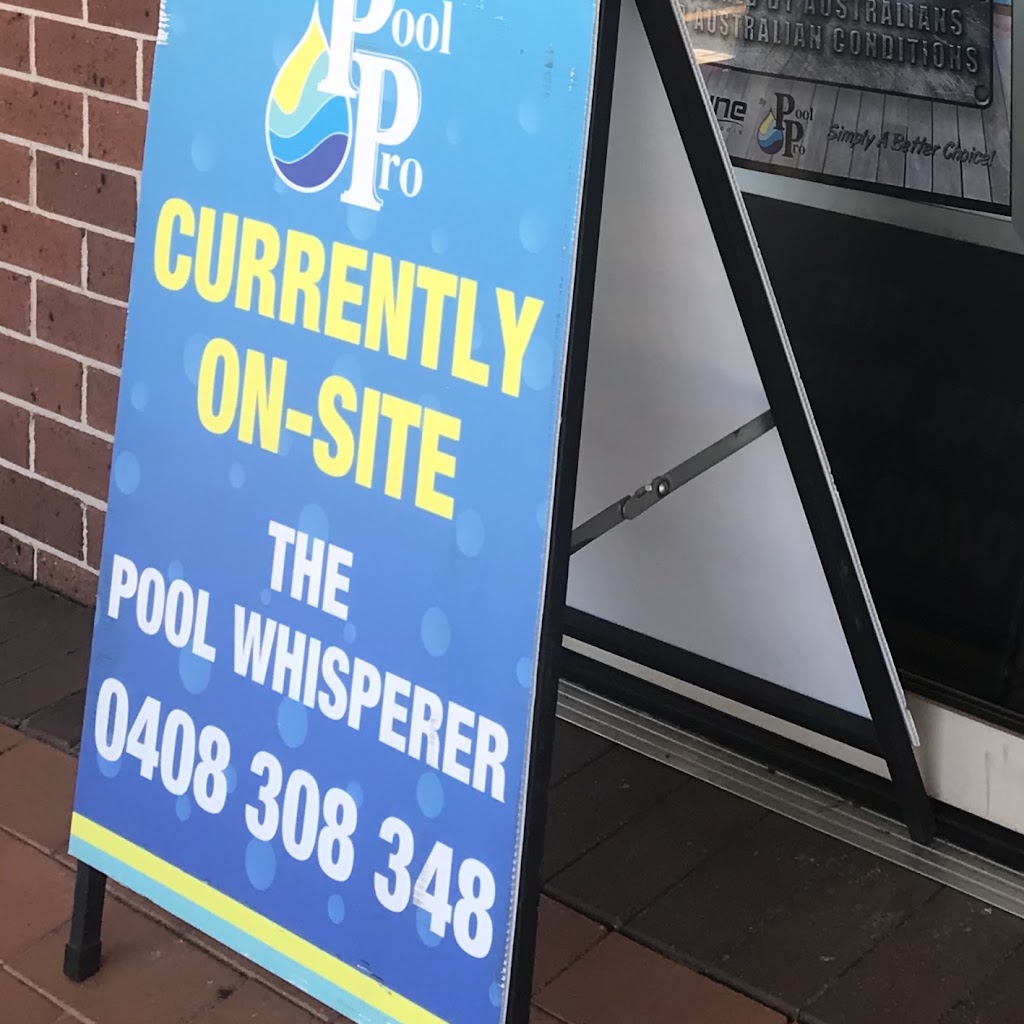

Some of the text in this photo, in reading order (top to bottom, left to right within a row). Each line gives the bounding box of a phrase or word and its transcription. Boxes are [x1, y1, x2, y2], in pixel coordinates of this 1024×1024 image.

[694, 7, 980, 74] AUSTRALIAN CONDITIONS
[340, 49, 423, 211] Pro
[774, 92, 813, 130] Pool
[781, 119, 806, 158] Pro
[827, 124, 997, 167] Simply A Better Choice!
[154, 197, 545, 397] CURRENTLY
[197, 337, 461, 520] ON-SITE
[268, 519, 353, 621] THE
[107, 554, 509, 804] POOL WHISPERER
[94, 678, 496, 959] 0408 308 348
